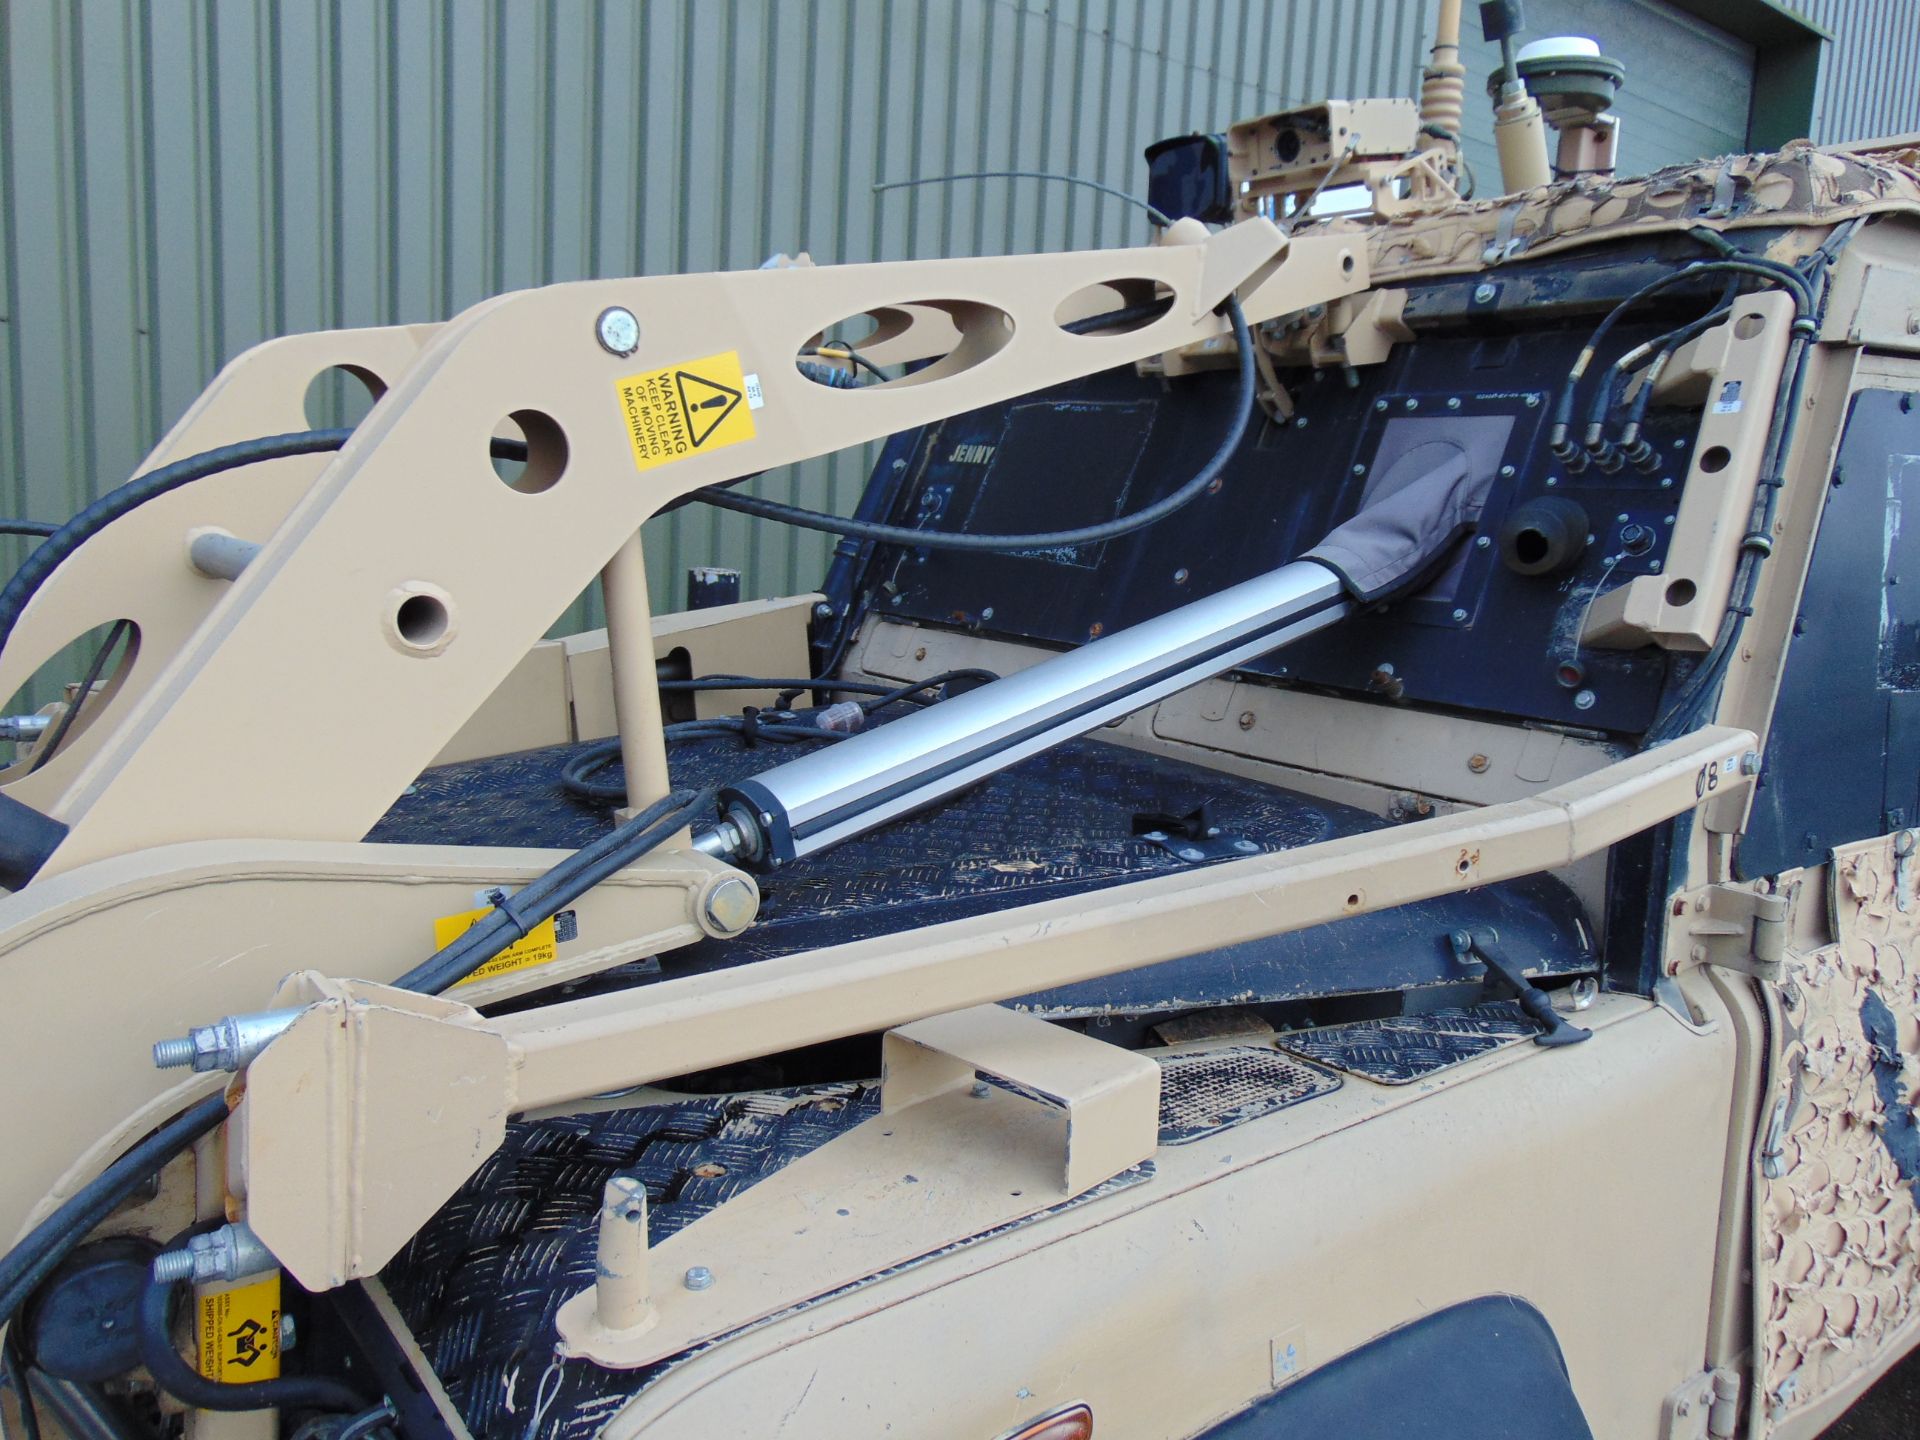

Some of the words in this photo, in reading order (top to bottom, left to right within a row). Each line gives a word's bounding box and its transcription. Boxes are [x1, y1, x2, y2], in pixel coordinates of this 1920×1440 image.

[623, 387, 650, 460] MACHINERY
[635, 386, 647, 402] OF
[641, 408, 660, 456] MOVING
[646, 378, 662, 411] KEEP
[656, 415, 673, 456] CLEAR
[658, 372, 688, 454] WARNING
[948, 444, 995, 465] JENNY
[487, 958, 522, 973] WEIGHT
[533, 951, 553, 961] 19kg
[205, 1298, 215, 1337] SHIPPED
[205, 1341, 215, 1377] WEIGHT
